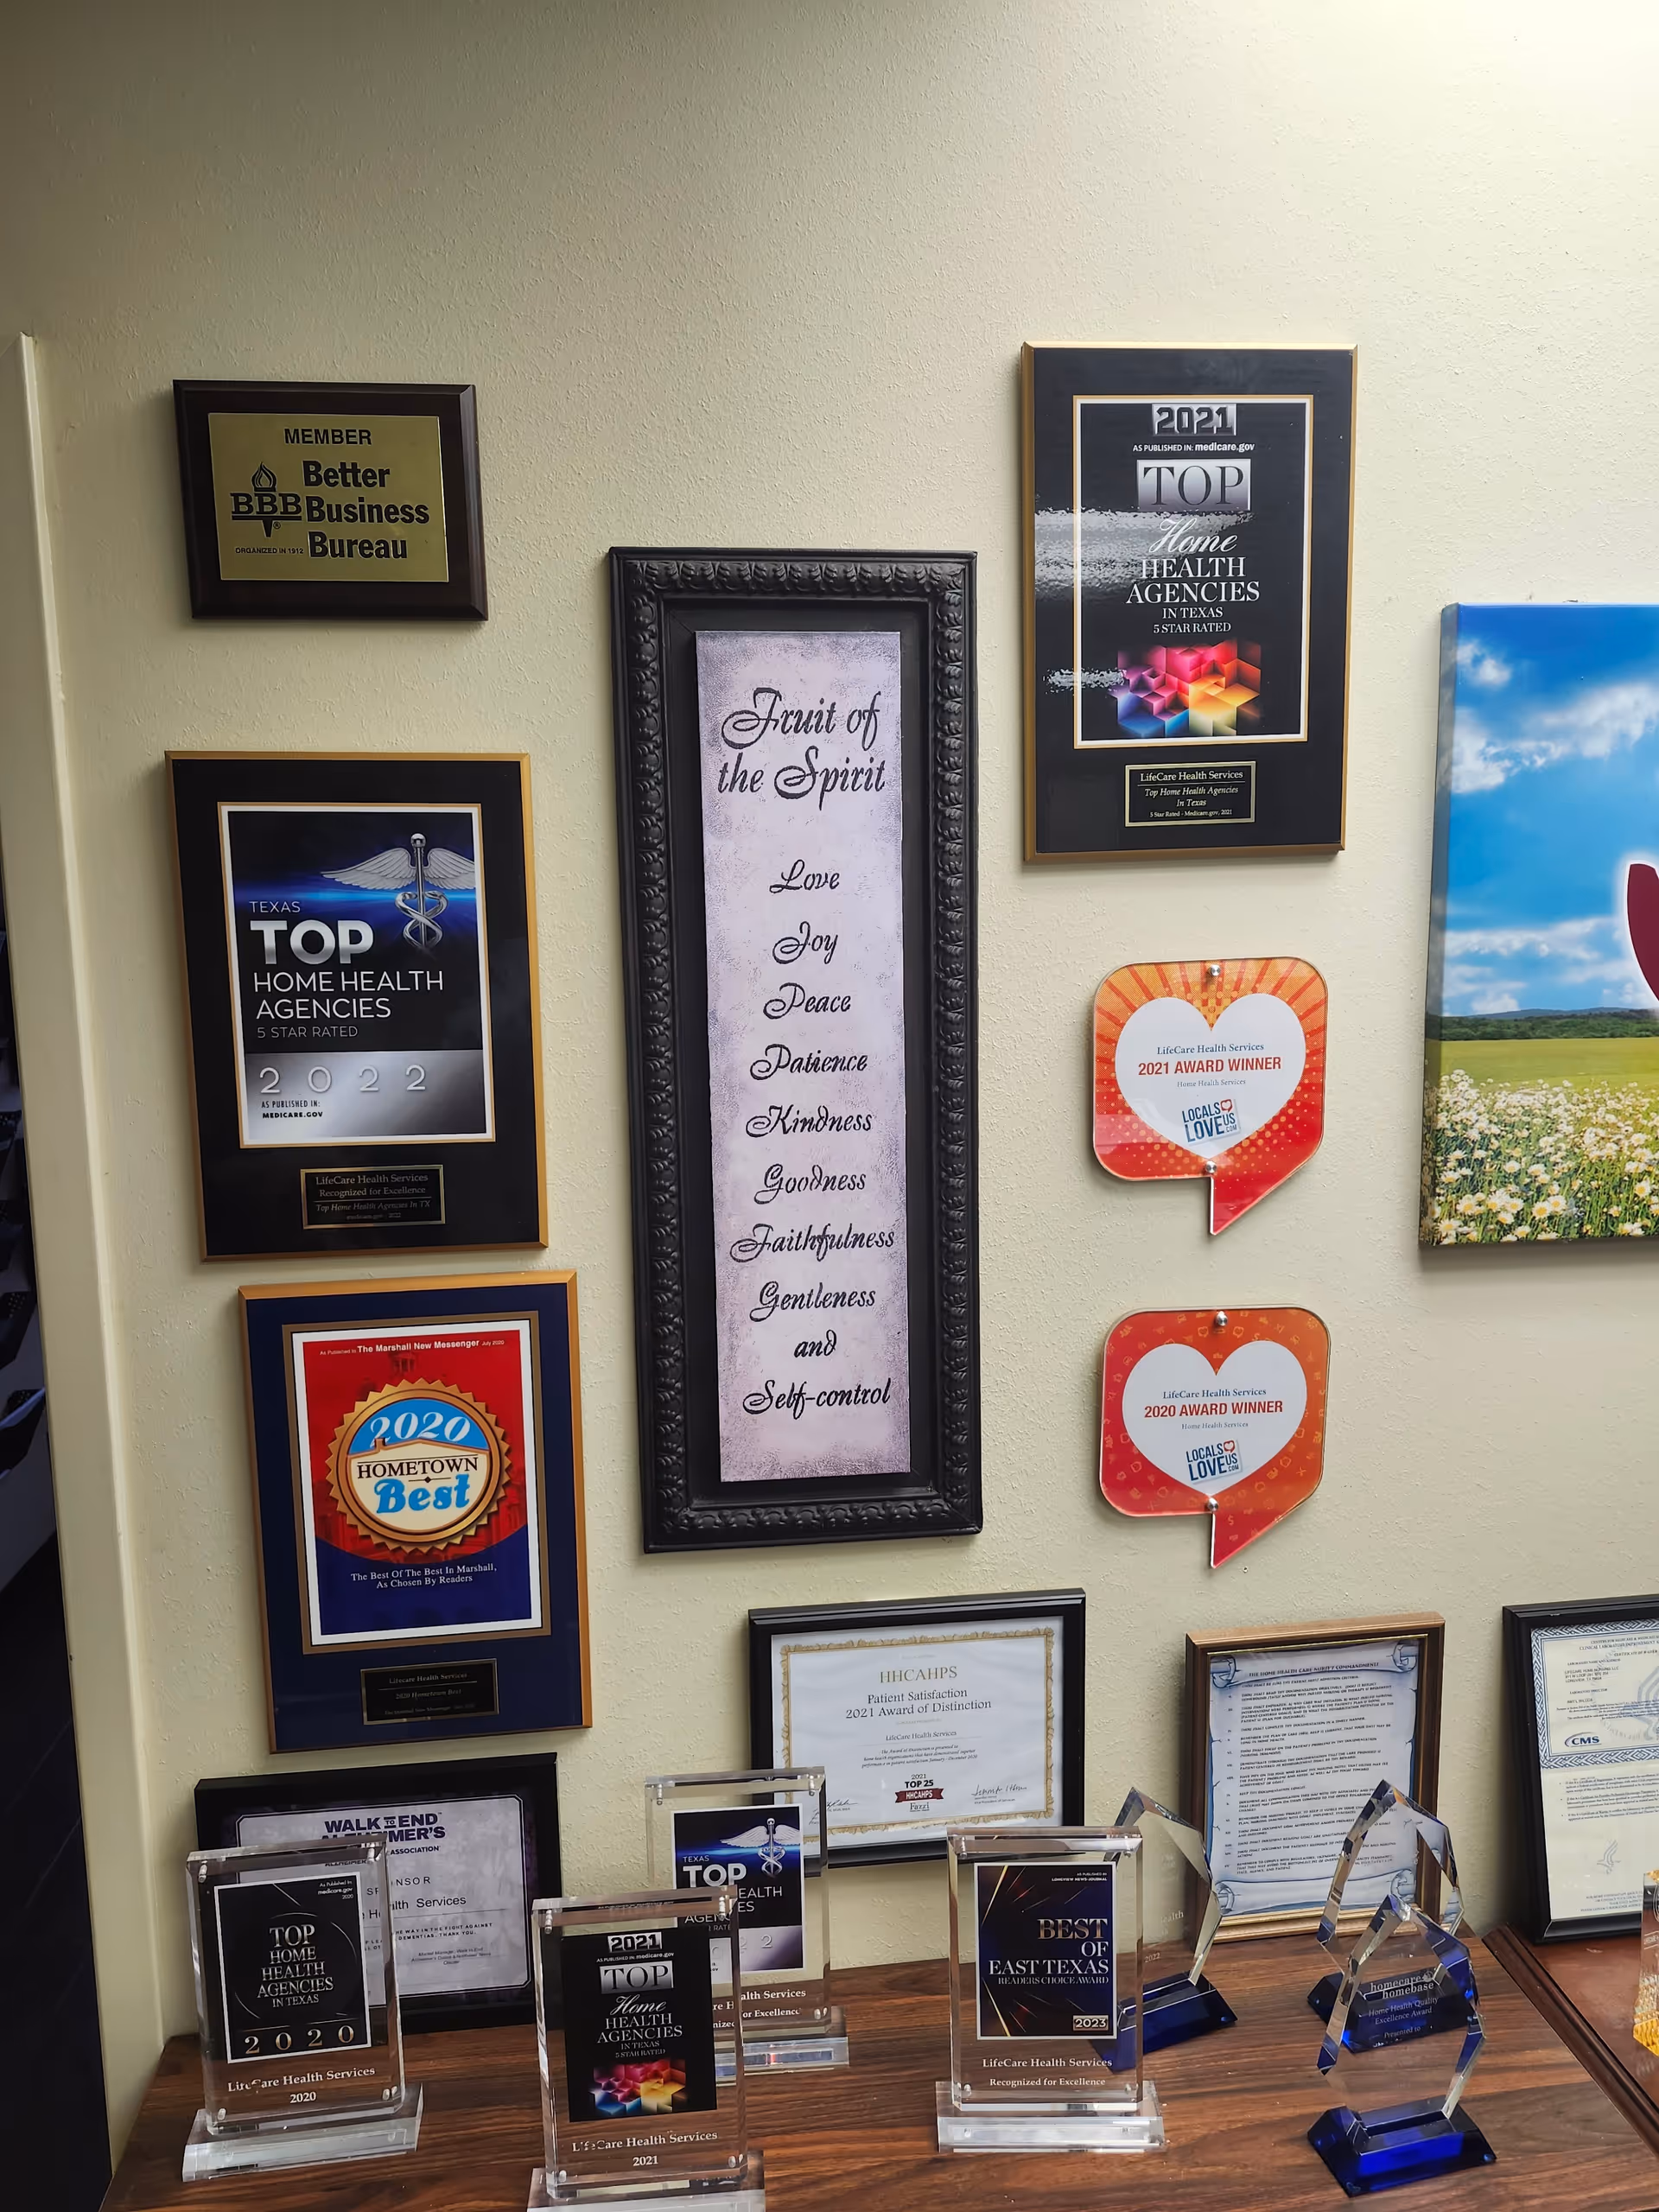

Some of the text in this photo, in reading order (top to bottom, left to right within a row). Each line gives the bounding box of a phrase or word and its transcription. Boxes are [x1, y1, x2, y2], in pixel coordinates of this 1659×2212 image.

[1155, 406, 1233, 435] 2021
[284, 429, 372, 445] MEMBER
[1195, 442, 1255, 453] medicare.gov
[302, 460, 390, 487] Better
[1142, 466, 1243, 505] TOP
[230, 493, 302, 515] BBB
[306, 496, 429, 524] Business
[308, 531, 407, 558] Bureau
[1148, 518, 1237, 553] Home
[1141, 556, 1246, 579] HEALTH
[1126, 581, 1260, 604] AGENCIES
[1162, 607, 1224, 619] IN TEXAS
[1153, 622, 1231, 633] 5 STAR RATED
[721, 688, 880, 751] Fruit of
[718, 746, 885, 810] the Spirit
[1141, 771, 1243, 782] LifeCare Health Services
[1144, 788, 1158, 798] Top
[1182, 786, 1205, 795] Health
[1208, 786, 1238, 796] Agencies
[769, 860, 839, 893] Love
[249, 901, 301, 913] TEXAS
[250, 919, 374, 965] TOP
[772, 921, 838, 964] Joy
[254, 970, 443, 993] HOME HEALTH
[256, 998, 391, 1020] AGENCIES
[763, 982, 852, 1020] Peace
[257, 1026, 358, 1038] 5 STAR RATED
[1157, 1043, 1264, 1055] LifeCare Health Services
[749, 1043, 868, 1081] Patience
[1138, 1057, 1281, 1075] 2021 AWARD WINNER
[262, 1110, 323, 1119] MEDICARE.GOV
[746, 1105, 873, 1137] Kindness
[1182, 1102, 1221, 1123] LOCALS
[1185, 1113, 1236, 1142] LOVE US
[316, 1176, 355, 1185] LifeCare
[358, 1175, 388, 1184] Health
[753, 1163, 866, 1205] Goodness
[729, 1223, 895, 1263] Faithfulness
[749, 1281, 876, 1322] Gentleness
[435, 1340, 480, 1350] Messenger
[794, 1330, 836, 1358] and
[742, 1377, 892, 1420] Self-control
[1163, 1390, 1199, 1399] LifeCare
[1233, 1388, 1266, 1396] Services
[1144, 1401, 1283, 1418] 2020 AWARD WINNER
[369, 1412, 471, 1447] 2020
[1186, 1444, 1224, 1463] LOCALS
[357, 1458, 479, 1479] HOMETOWN
[1188, 1453, 1237, 1481] LOVE US
[375, 1474, 471, 1514] Best
[351, 1562, 497, 1581] The Best Of The Best In Marshall,
[376, 1573, 473, 1589] As Chosen By Readers
[880, 1666, 957, 1683] HHCAHPS
[868, 1688, 968, 1704] Patient Satisfaction
[845, 1700, 991, 1719] 2021 Award of Distinction
[1571, 1735, 1599, 1745] CMS
[906, 1790, 932, 1799] HHCAHPS
[325, 1817, 380, 1834] WALK
[398, 1814, 438, 1827] END
[391, 1846, 439, 1855] ASSOCIATION
[683, 1854, 709, 1863] TEXAS
[683, 1863, 747, 1888] TOP
[416, 1897, 467, 1908] Services
[269, 1924, 315, 1948] TOP
[1038, 1919, 1108, 1940] BEST
[610, 1934, 660, 1951] 2021
[1081, 1942, 1109, 1957] OF
[269, 1947, 317, 1964] HOME
[1145, 1953, 1160, 1963] 2022
[262, 1961, 326, 1982] HEALTH
[604, 1965, 669, 1990] TOP
[988, 1960, 1109, 1976] EAST TEXAS
[257, 1977, 334, 1999] AGENCIES
[998, 1976, 1109, 1986] READERS CHOICE AWARD
[1370, 1975, 1421, 1992] homecare
[1382, 1982, 1434, 1999] homebase
[764, 1990, 806, 1999] Services
[610, 1994, 667, 2015] Home
[1369, 1998, 1438, 2017] Home Health Quality
[606, 2013, 672, 2030] HEALTH
[1075, 2018, 1107, 2029] 2023
[1376, 2006, 1433, 2024] Excellence Award
[596, 2024, 683, 2044] AGENCIES
[982, 2057, 1113, 2068] LifeCare Health Services
[283, 2067, 375, 2087] Health Services
[989, 2077, 1105, 2088] Recognized for Excellence
[289, 2091, 317, 2104] 2020
[626, 2130, 718, 2148] Health Services
[632, 2156, 658, 2166] 2021
